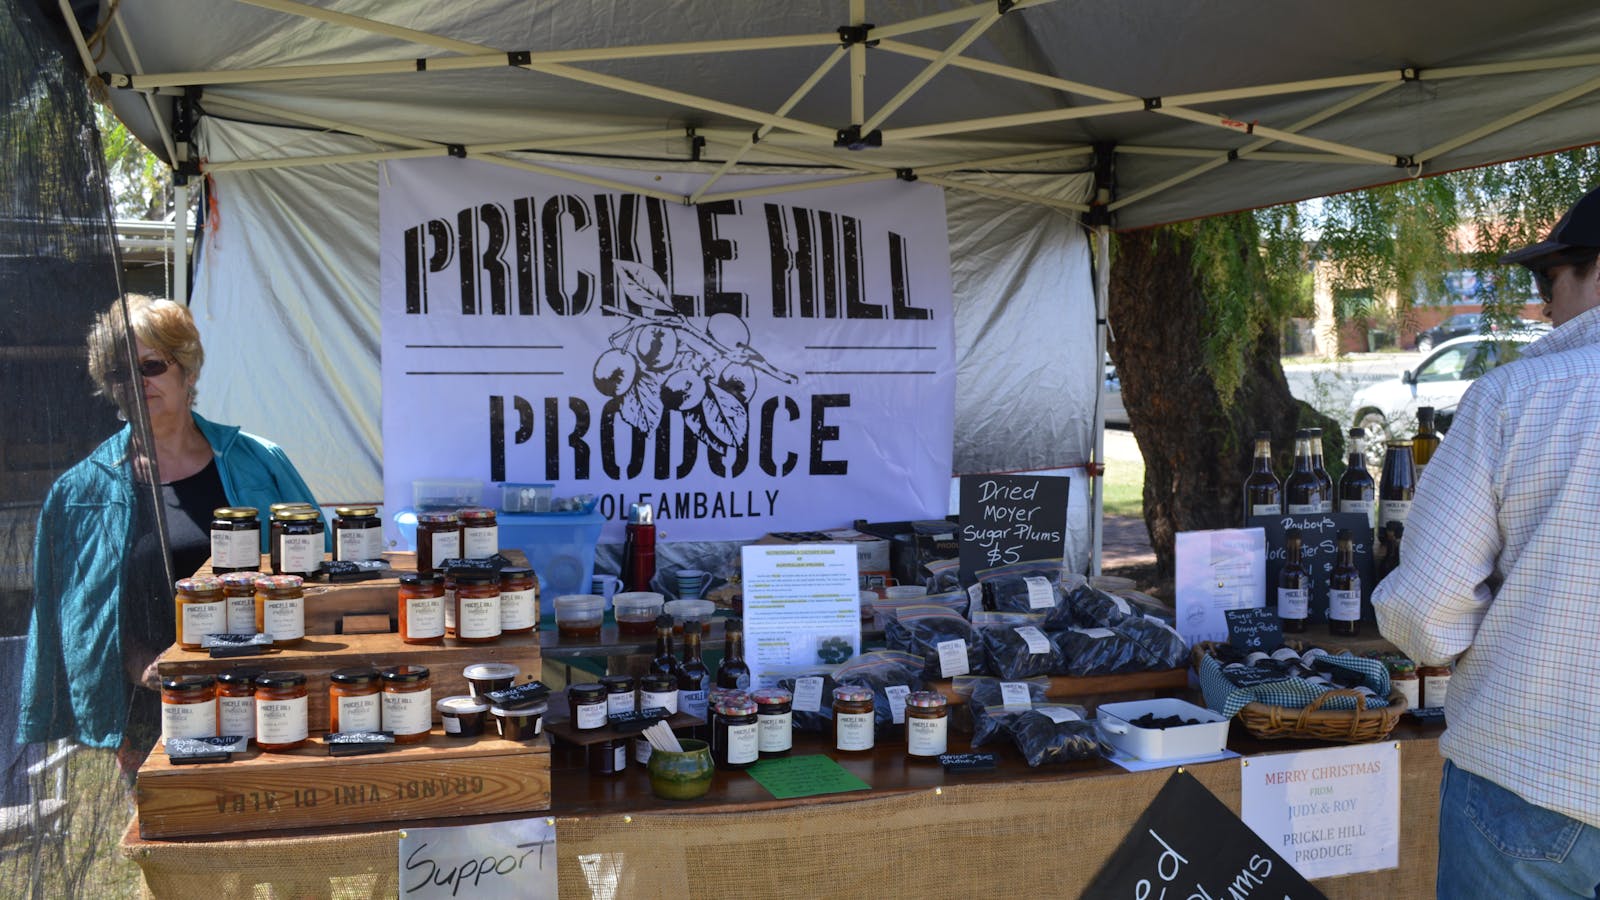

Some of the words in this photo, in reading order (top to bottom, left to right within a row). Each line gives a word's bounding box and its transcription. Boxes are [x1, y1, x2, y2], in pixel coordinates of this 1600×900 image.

[404, 193, 751, 318] PRICKLE
[763, 203, 933, 320] HILL
[490, 394, 851, 483] PRODUCE
[978, 480, 1040, 503] Dried
[600, 488, 780, 521] OLAMBALLY
[963, 525, 1011, 547] Sugar
[1014, 524, 1060, 543] Plums
[987, 542, 1023, 567] $5
[1265, 770, 1308, 786] MERRY
[1312, 761, 1381, 780] CHRISTMAS
[215, 790, 277, 814] ALBA
[294, 787, 318, 808] DI
[335, 783, 381, 805] VINI
[1310, 785, 1333, 797] FROM
[1288, 803, 1317, 820] JUDY
[1320, 802, 1331, 815] &
[1333, 799, 1358, 813] ROY
[1283, 828, 1335, 846] PRICKLE
[1338, 824, 1366, 839] HILL
[1295, 843, 1353, 863] PRODUCE
[406, 834, 555, 897] Support
